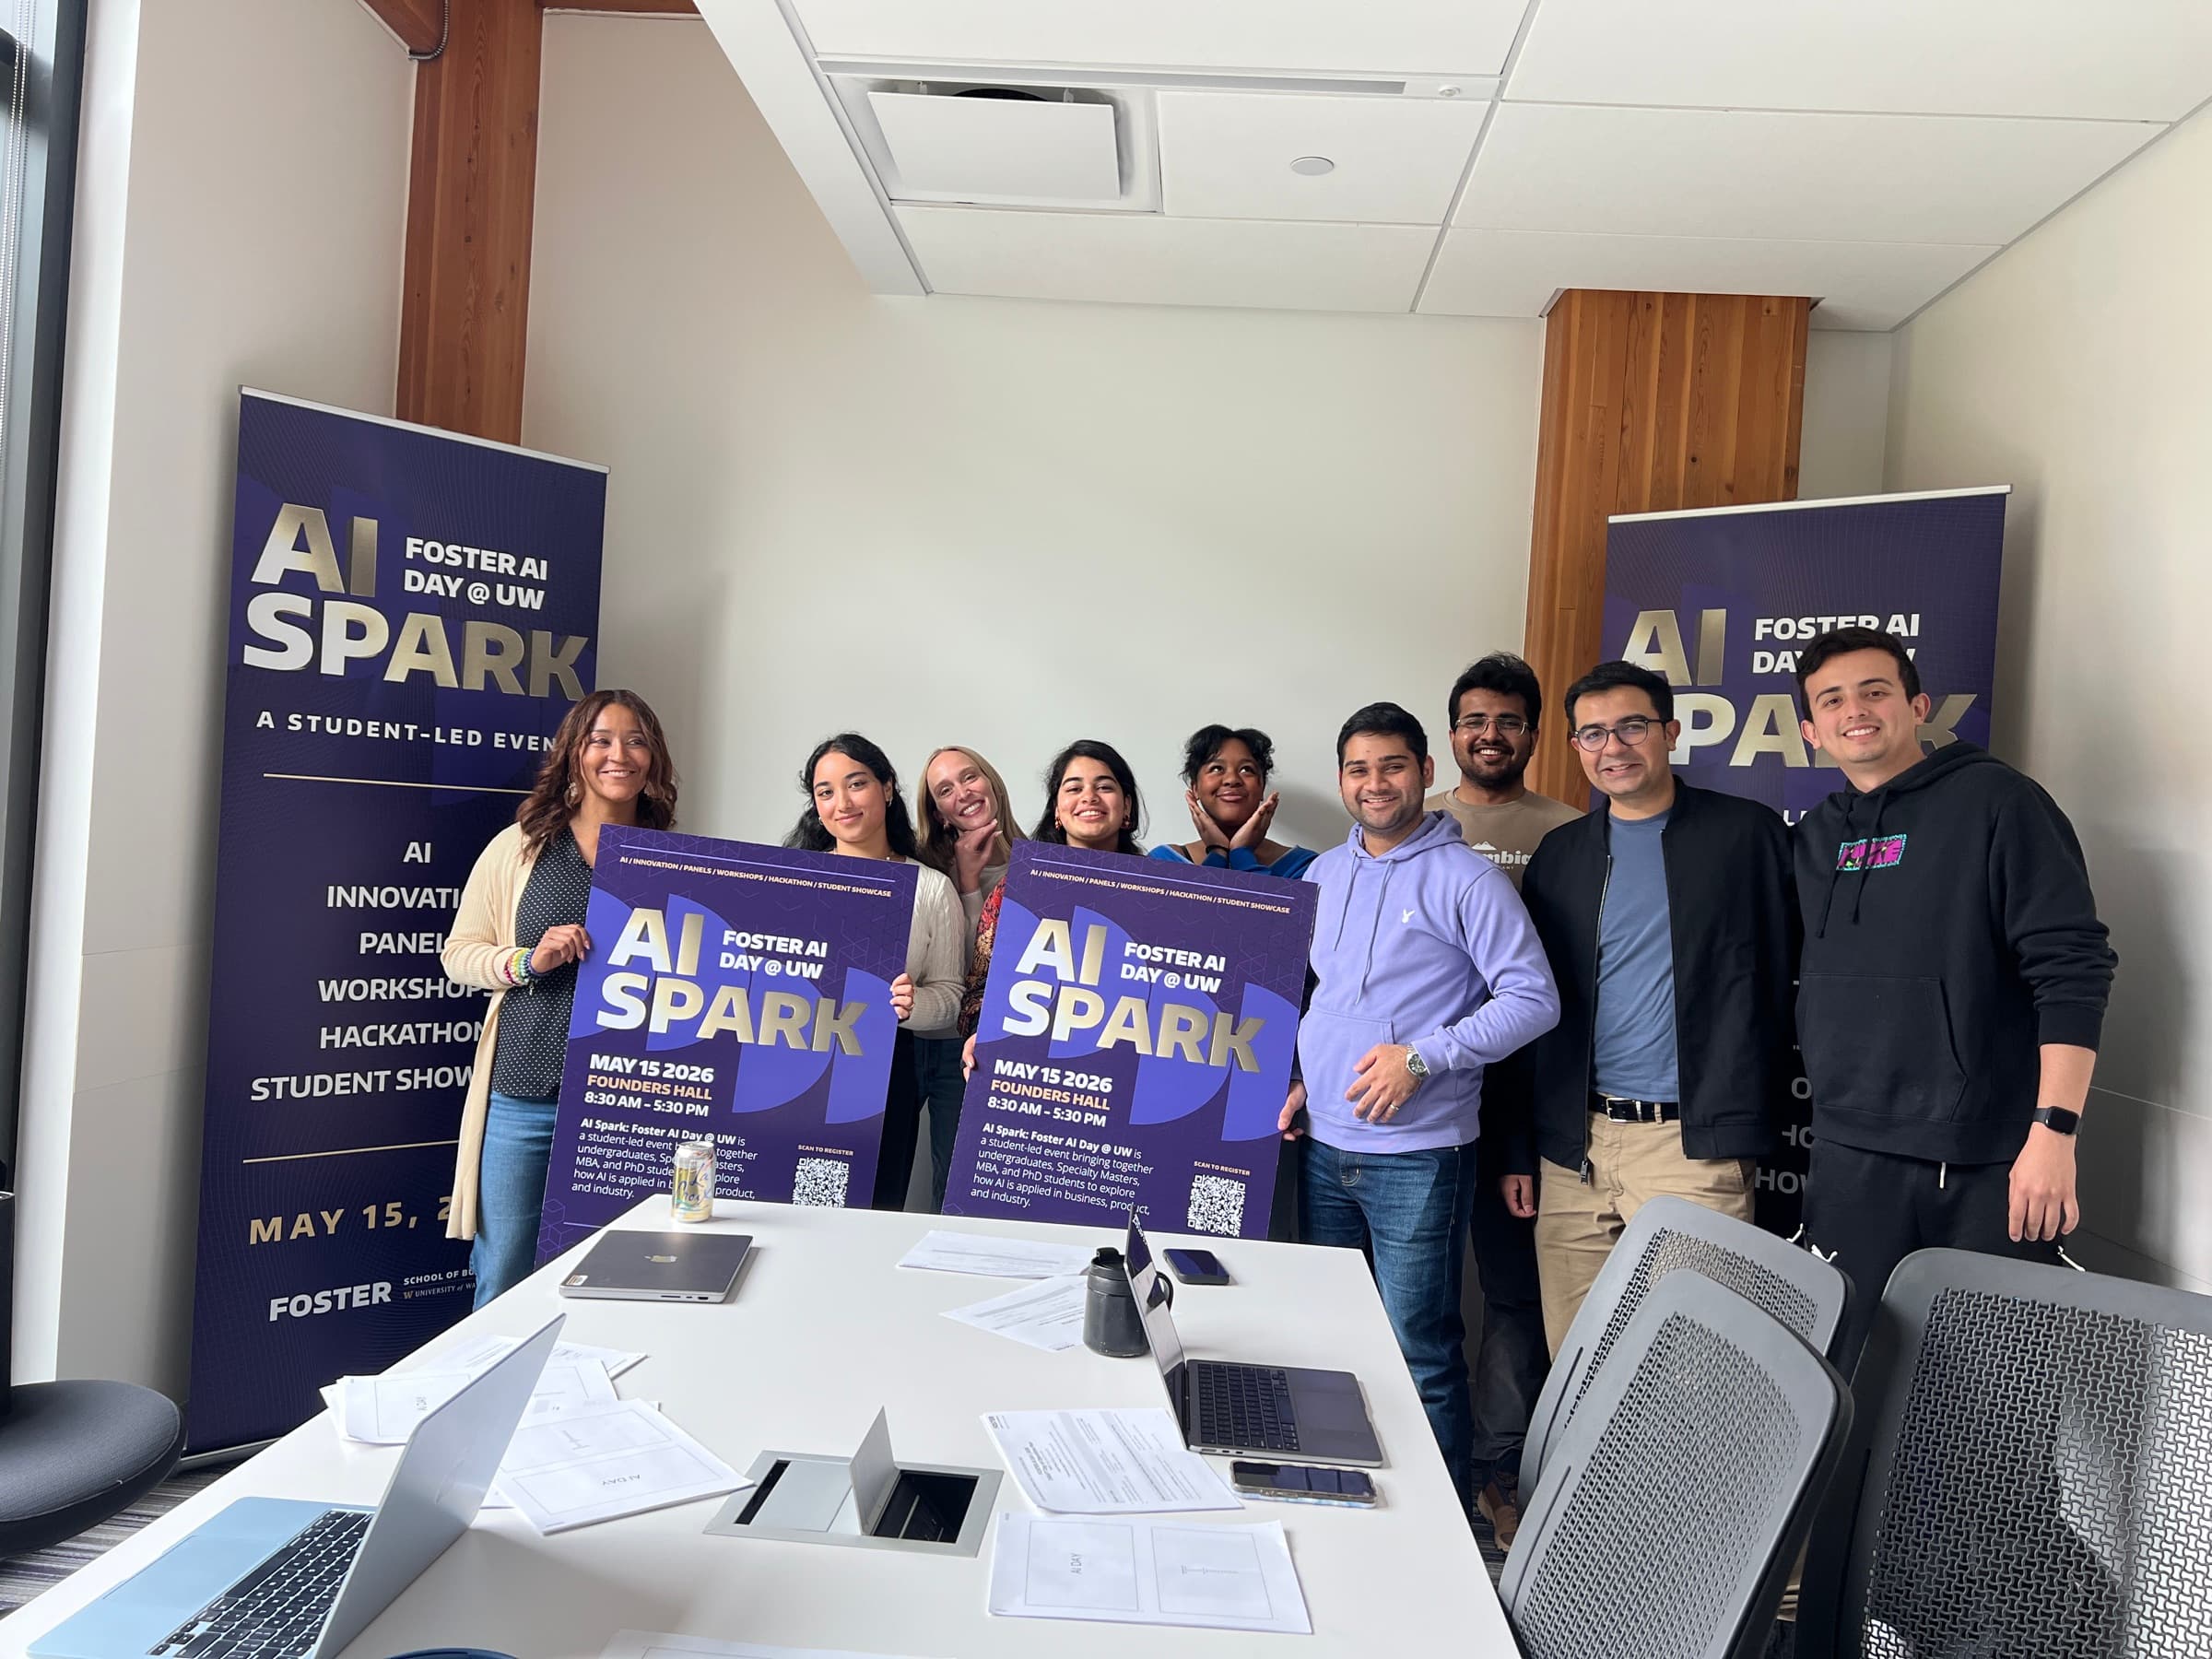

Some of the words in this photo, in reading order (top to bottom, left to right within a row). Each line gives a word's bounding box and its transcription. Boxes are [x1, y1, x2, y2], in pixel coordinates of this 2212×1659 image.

[251, 503, 378, 597] AI
[406, 536, 516, 574] FOSTER
[519, 559, 547, 581] AI
[404, 570, 464, 599] DAY
[467, 582, 490, 605] @
[496, 584, 545, 610] UW
[1887, 614, 1920, 637] AI
[243, 593, 588, 701] SPARK
[1621, 608, 1727, 686] AI
[1753, 651, 1804, 674] DA
[256, 712, 275, 728] A
[288, 713, 483, 746] STUDENT-LED
[494, 732, 558, 752] EVEN
[403, 841, 431, 864] AI
[632, 858, 679, 870] INNOVATION
[683, 865, 712, 874] PANELS
[716, 869, 764, 881] WORKSHOPS
[768, 876, 814, 888] HACKATHON
[818, 882, 852, 892] STUDENT
[852, 886, 891, 897] SHOWCASE
[1041, 871, 1085, 883] INNOVATION
[1088, 877, 1116, 888] PANELS
[1120, 882, 1165, 895] WORKSHOPS
[1169, 889, 1213, 902] HACKATHON
[1217, 897, 1251, 908] STUDENT
[1250, 902, 1290, 913] SHOWCASE
[327, 886, 460, 909] INNOVATI
[359, 932, 444, 954] PANEL
[606, 907, 704, 977] AI
[722, 930, 804, 955] FOSTER
[804, 940, 828, 958] AI
[1014, 917, 1107, 987] AI
[1124, 941, 1203, 969] FOSTER
[1203, 955, 1226, 972] AI
[719, 952, 764, 971] DAY
[764, 959, 782, 976] @
[785, 960, 824, 979] UW
[1120, 963, 1164, 983] DAY
[1163, 972, 1181, 989] @
[1183, 973, 1221, 994] UW
[318, 977, 492, 1002] WORKSHOP
[595, 971, 872, 1056] SPARK
[1002, 980, 1266, 1073] SPARK
[251, 1070, 391, 1101] STUDENT
[395, 1065, 473, 1092] SHOW
[589, 1053, 638, 1074] MAY
[639, 1060, 660, 1077] 15
[662, 1063, 714, 1083] 2026
[994, 1059, 1040, 1080] MAY
[1041, 1067, 1061, 1084] 15
[1062, 1070, 1112, 1093] 2026
[587, 1074, 671, 1095] FOUNDERS
[673, 1085, 712, 1100] HALL
[991, 1079, 1071, 1103] FOUNDERS
[1072, 1093, 1111, 1111] HALL
[584, 1091, 617, 1106] 8:30
[617, 1095, 642, 1109] AM
[653, 1100, 684, 1114] 5:30
[685, 1103, 709, 1117] PM
[987, 1096, 1018, 1112] 8:30
[1018, 1101, 1042, 1116] AM
[1053, 1107, 1082, 1123] 5:30
[1083, 1112, 1107, 1127] PM
[579, 1132, 586, 1140] a
[587, 1133, 644, 1147] student-led
[645, 1140, 673, 1151] event
[716, 1147, 758, 1160] together
[581, 1118, 594, 1128] AI
[594, 1119, 629, 1133] Spark:
[631, 1124, 666, 1136] Foster
[666, 1128, 679, 1138] AI
[682, 1130, 702, 1143] Day
[704, 1133, 714, 1142] @
[717, 1134, 736, 1145] UW
[737, 1136, 746, 1147] is
[982, 1123, 994, 1134] AI
[995, 1124, 1030, 1140] Spark:
[1030, 1131, 1065, 1145] Foster
[1065, 1136, 1077, 1147] AI
[1078, 1139, 1100, 1154] Day
[1100, 1144, 1112, 1154] @
[1113, 1145, 1133, 1158] UW
[1134, 1148, 1142, 1159] is
[577, 1145, 657, 1163] undergraduates,
[715, 1161, 745, 1172] sters,
[824, 1147, 853, 1156] REGISTER
[980, 1136, 987, 1145] a
[988, 1138, 1042, 1155] student-led
[1043, 1148, 1070, 1160] event
[1072, 1150, 1111, 1170] bringing
[1112, 1159, 1154, 1174] together
[573, 1168, 595, 1180] how
[595, 1171, 606, 1182] AI
[608, 1172, 617, 1182] is
[618, 1175, 655, 1187] applied
[656, 1178, 666, 1188] in
[715, 1187, 755, 1199] product,
[575, 1156, 600, 1169] MBA,
[602, 1160, 622, 1171] and
[624, 1161, 645, 1173] PhD
[647, 1166, 675, 1176] stude
[715, 1172, 740, 1183] plore
[976, 1160, 999, 1175] MBA,
[1001, 1167, 1021, 1178] and
[1022, 1169, 1042, 1182] PhD
[1043, 1174, 1086, 1189] students
[1087, 1182, 1098, 1192] to
[1100, 1184, 1135, 1198] explore
[978, 1149, 1054, 1171] undergraduates,
[1056, 1161, 1099, 1181] Specialty
[1100, 1170, 1140, 1187] Masters,
[1194, 1160, 1211, 1169] SCAN
[1219, 1165, 1251, 1176] REGISTER
[571, 1182, 592, 1193] and
[593, 1183, 634, 1200] industry.
[971, 1188, 990, 1199] and
[991, 1190, 1030, 1208] industry.
[973, 1172, 994, 1186] how
[994, 1178, 1006, 1188] AI
[1006, 1179, 1015, 1190] is
[1016, 1182, 1052, 1196] applied
[1053, 1187, 1063, 1198] in
[1064, 1189, 1108, 1208] business,
[249, 1208, 345, 1244] MAY
[362, 1202, 418, 1229] 15,
[404, 1273, 443, 1286] SCHOOL
[446, 1270, 459, 1278] OF
[415, 1286, 455, 1297] UNIVERSITY
[269, 1281, 392, 1322] FOSTER
